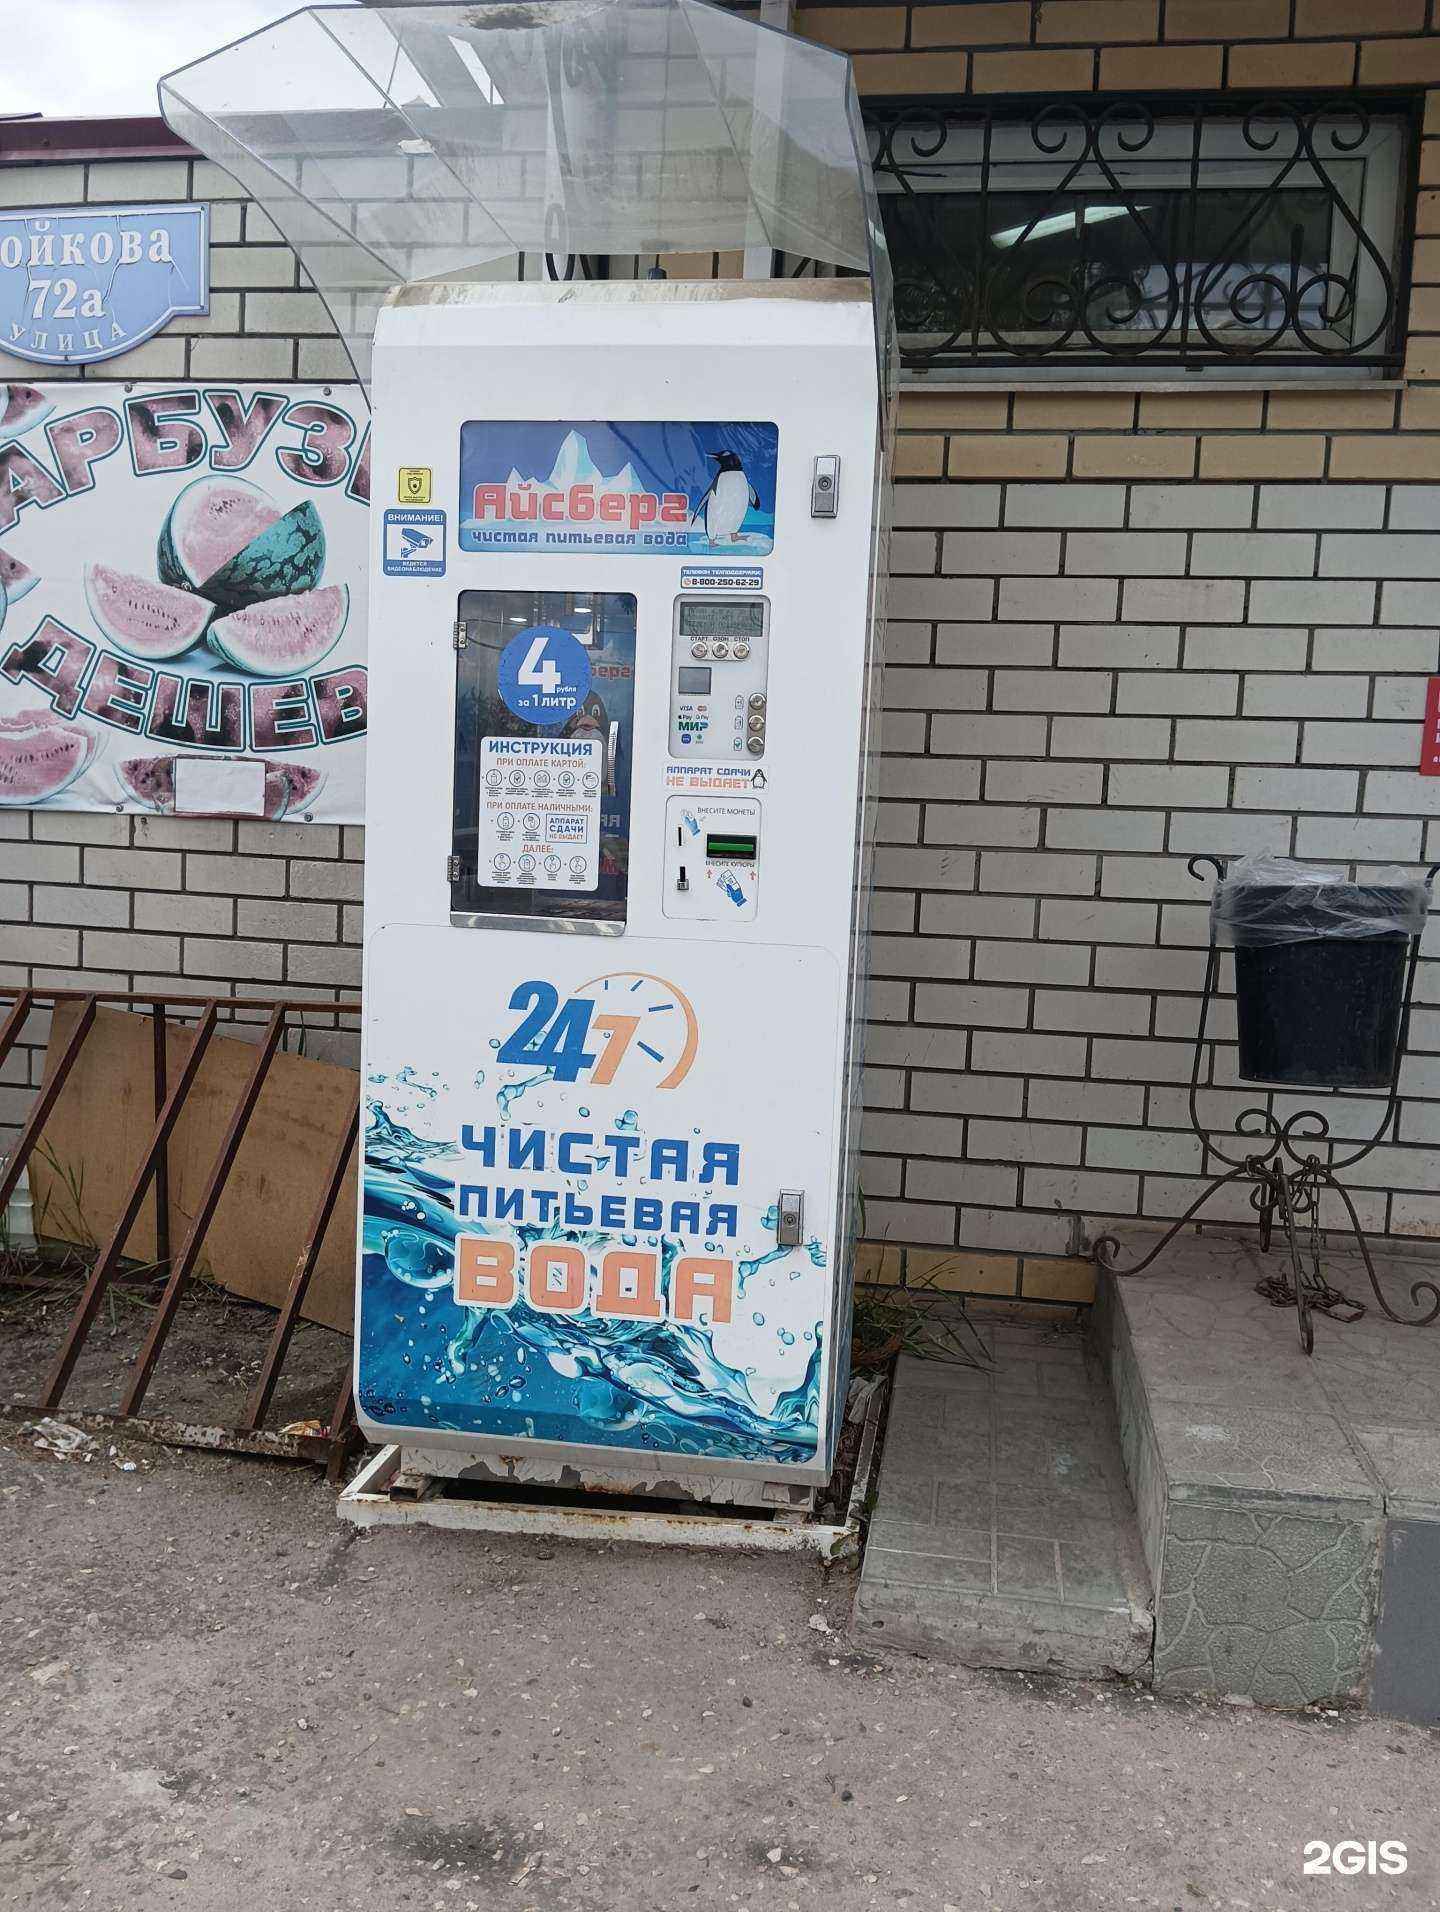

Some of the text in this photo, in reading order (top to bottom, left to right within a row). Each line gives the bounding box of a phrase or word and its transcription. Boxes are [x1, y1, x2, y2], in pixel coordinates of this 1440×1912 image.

[28, 278, 106, 319] 72а
[0, 389, 370, 535] АРБУЗ
[473, 482, 690, 531] Айсберг
[387, 513, 444, 523] ВНИМАНИЕ!
[471, 531, 688, 547] чистая питьевая вода
[518, 637, 561, 694] 4
[518, 694, 577, 710] за 1 литр
[678, 721, 710, 732] МИР
[489, 740, 593, 756] ИНСТРУКЦИЯ
[496, 757, 514, 767] ПРИ
[516, 758, 549, 768] ОПЛАТЕ
[666, 766, 752, 777] АППАРАТ СДАЧИ
[666, 776, 684, 787] НЕ
[487, 801, 503, 810] ПРИ
[505, 802, 536, 812] ОПЛАТЕ
[697, 807, 726, 815] ВНЕСИТЕ
[549, 817, 585, 825] АППАРАТ
[549, 824, 584, 834] СДАЧИ
[461, 1123, 741, 1187] ЧИСТАЯ
[458, 1183, 738, 1238] ПИТЬЕВАЯ
[457, 1237, 734, 1324] ВОДА
